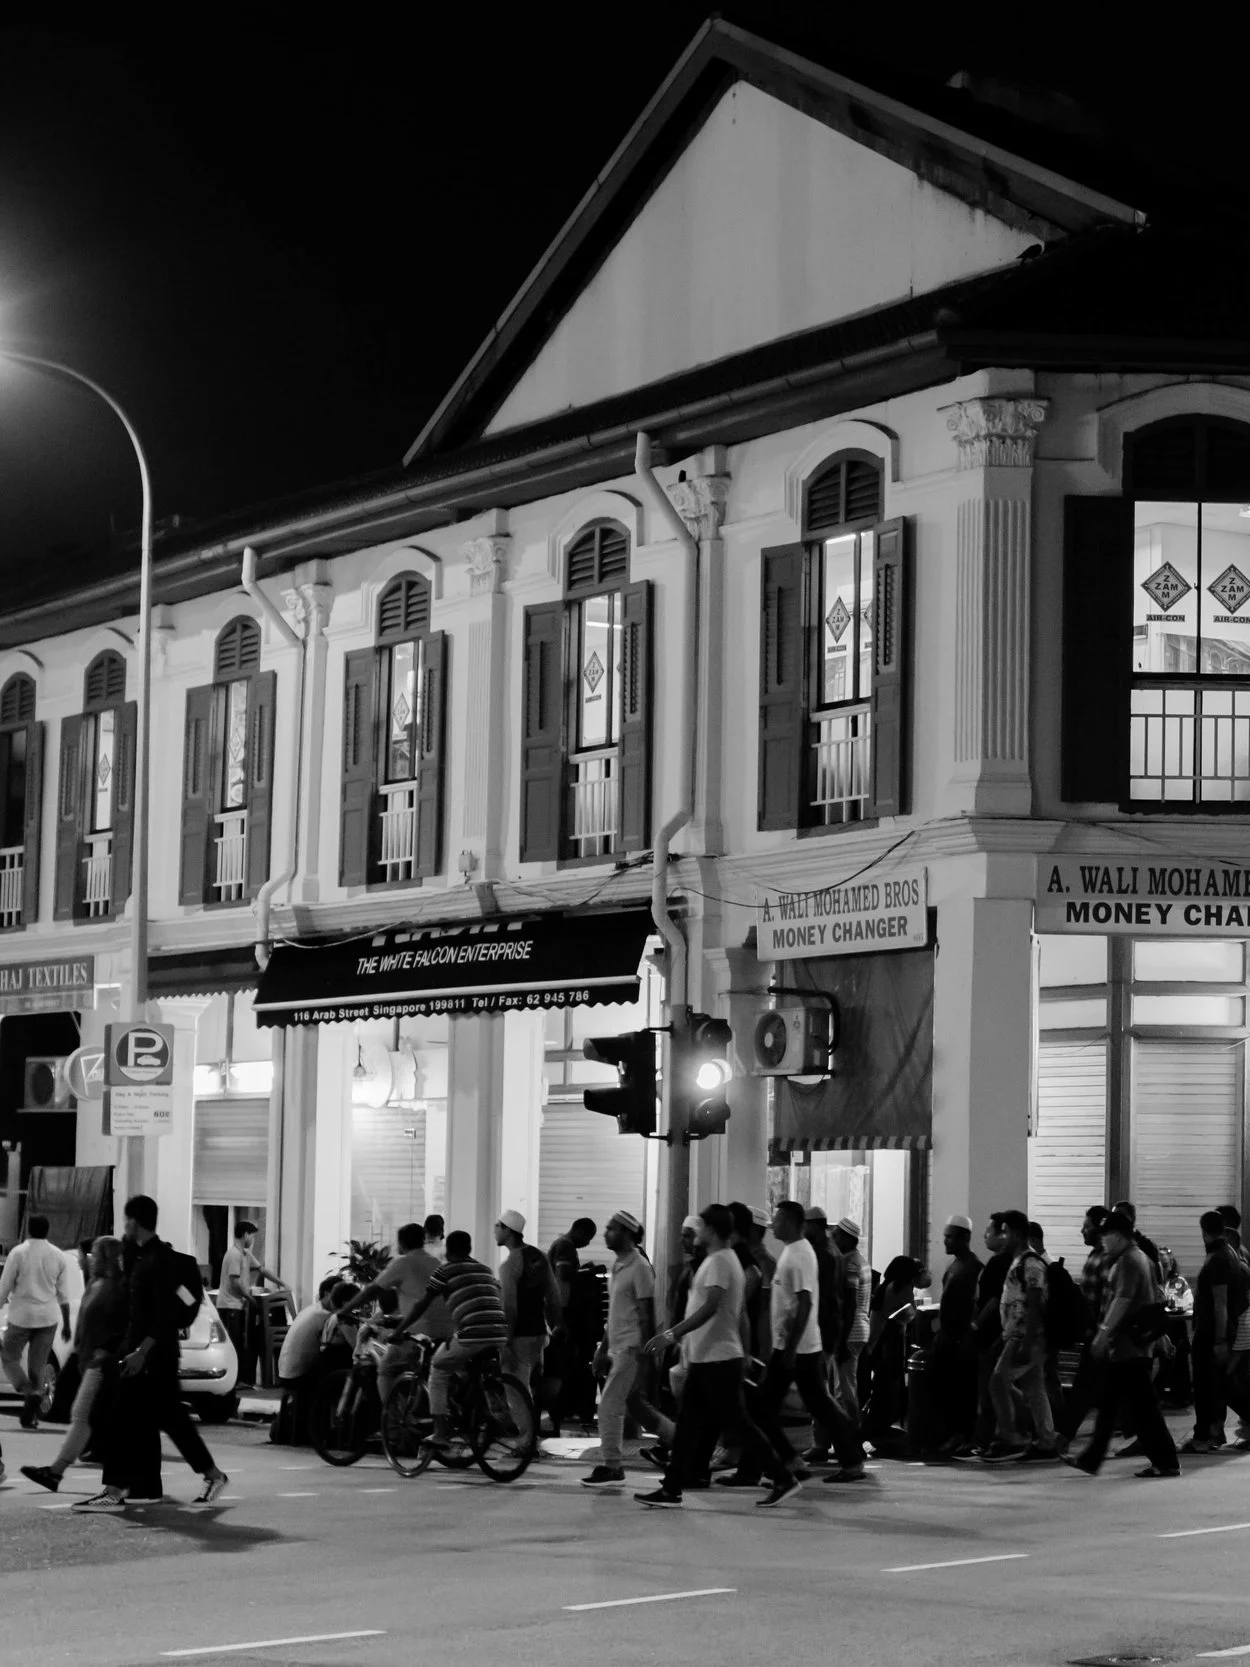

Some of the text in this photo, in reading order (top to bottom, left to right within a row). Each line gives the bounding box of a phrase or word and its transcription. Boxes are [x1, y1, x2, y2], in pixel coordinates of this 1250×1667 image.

[1154, 582, 1178, 591] ZAM
[1146, 614, 1185, 622] AIR-CON
[1047, 865, 1070, 893] A.
[1080, 866, 1140, 894] WALI
[778, 893, 809, 920] WALI
[813, 884, 880, 918] MOHAMED
[884, 879, 919, 908] BROS
[1066, 902, 1174, 925] MONEY
[772, 916, 908, 949] MONEY CHANGER
[356, 940, 534, 975] THE WHITE FALCON ENTERPRISE
[28, 963, 88, 988] TEXTILES
[294, 1012, 310, 1022] 116
[312, 1010, 336, 1020] Arab
[338, 1007, 369, 1018] Street
[373, 1003, 426, 1016] Singapore
[430, 999, 465, 1010] 199811
[472, 997, 488, 1008] Tel
[499, 995, 522, 1006] Fax:
[526, 994, 540, 1004] 62
[544, 992, 564, 1003] 945
[569, 990, 590, 1002] 786
[128, 1032, 164, 1066] P
